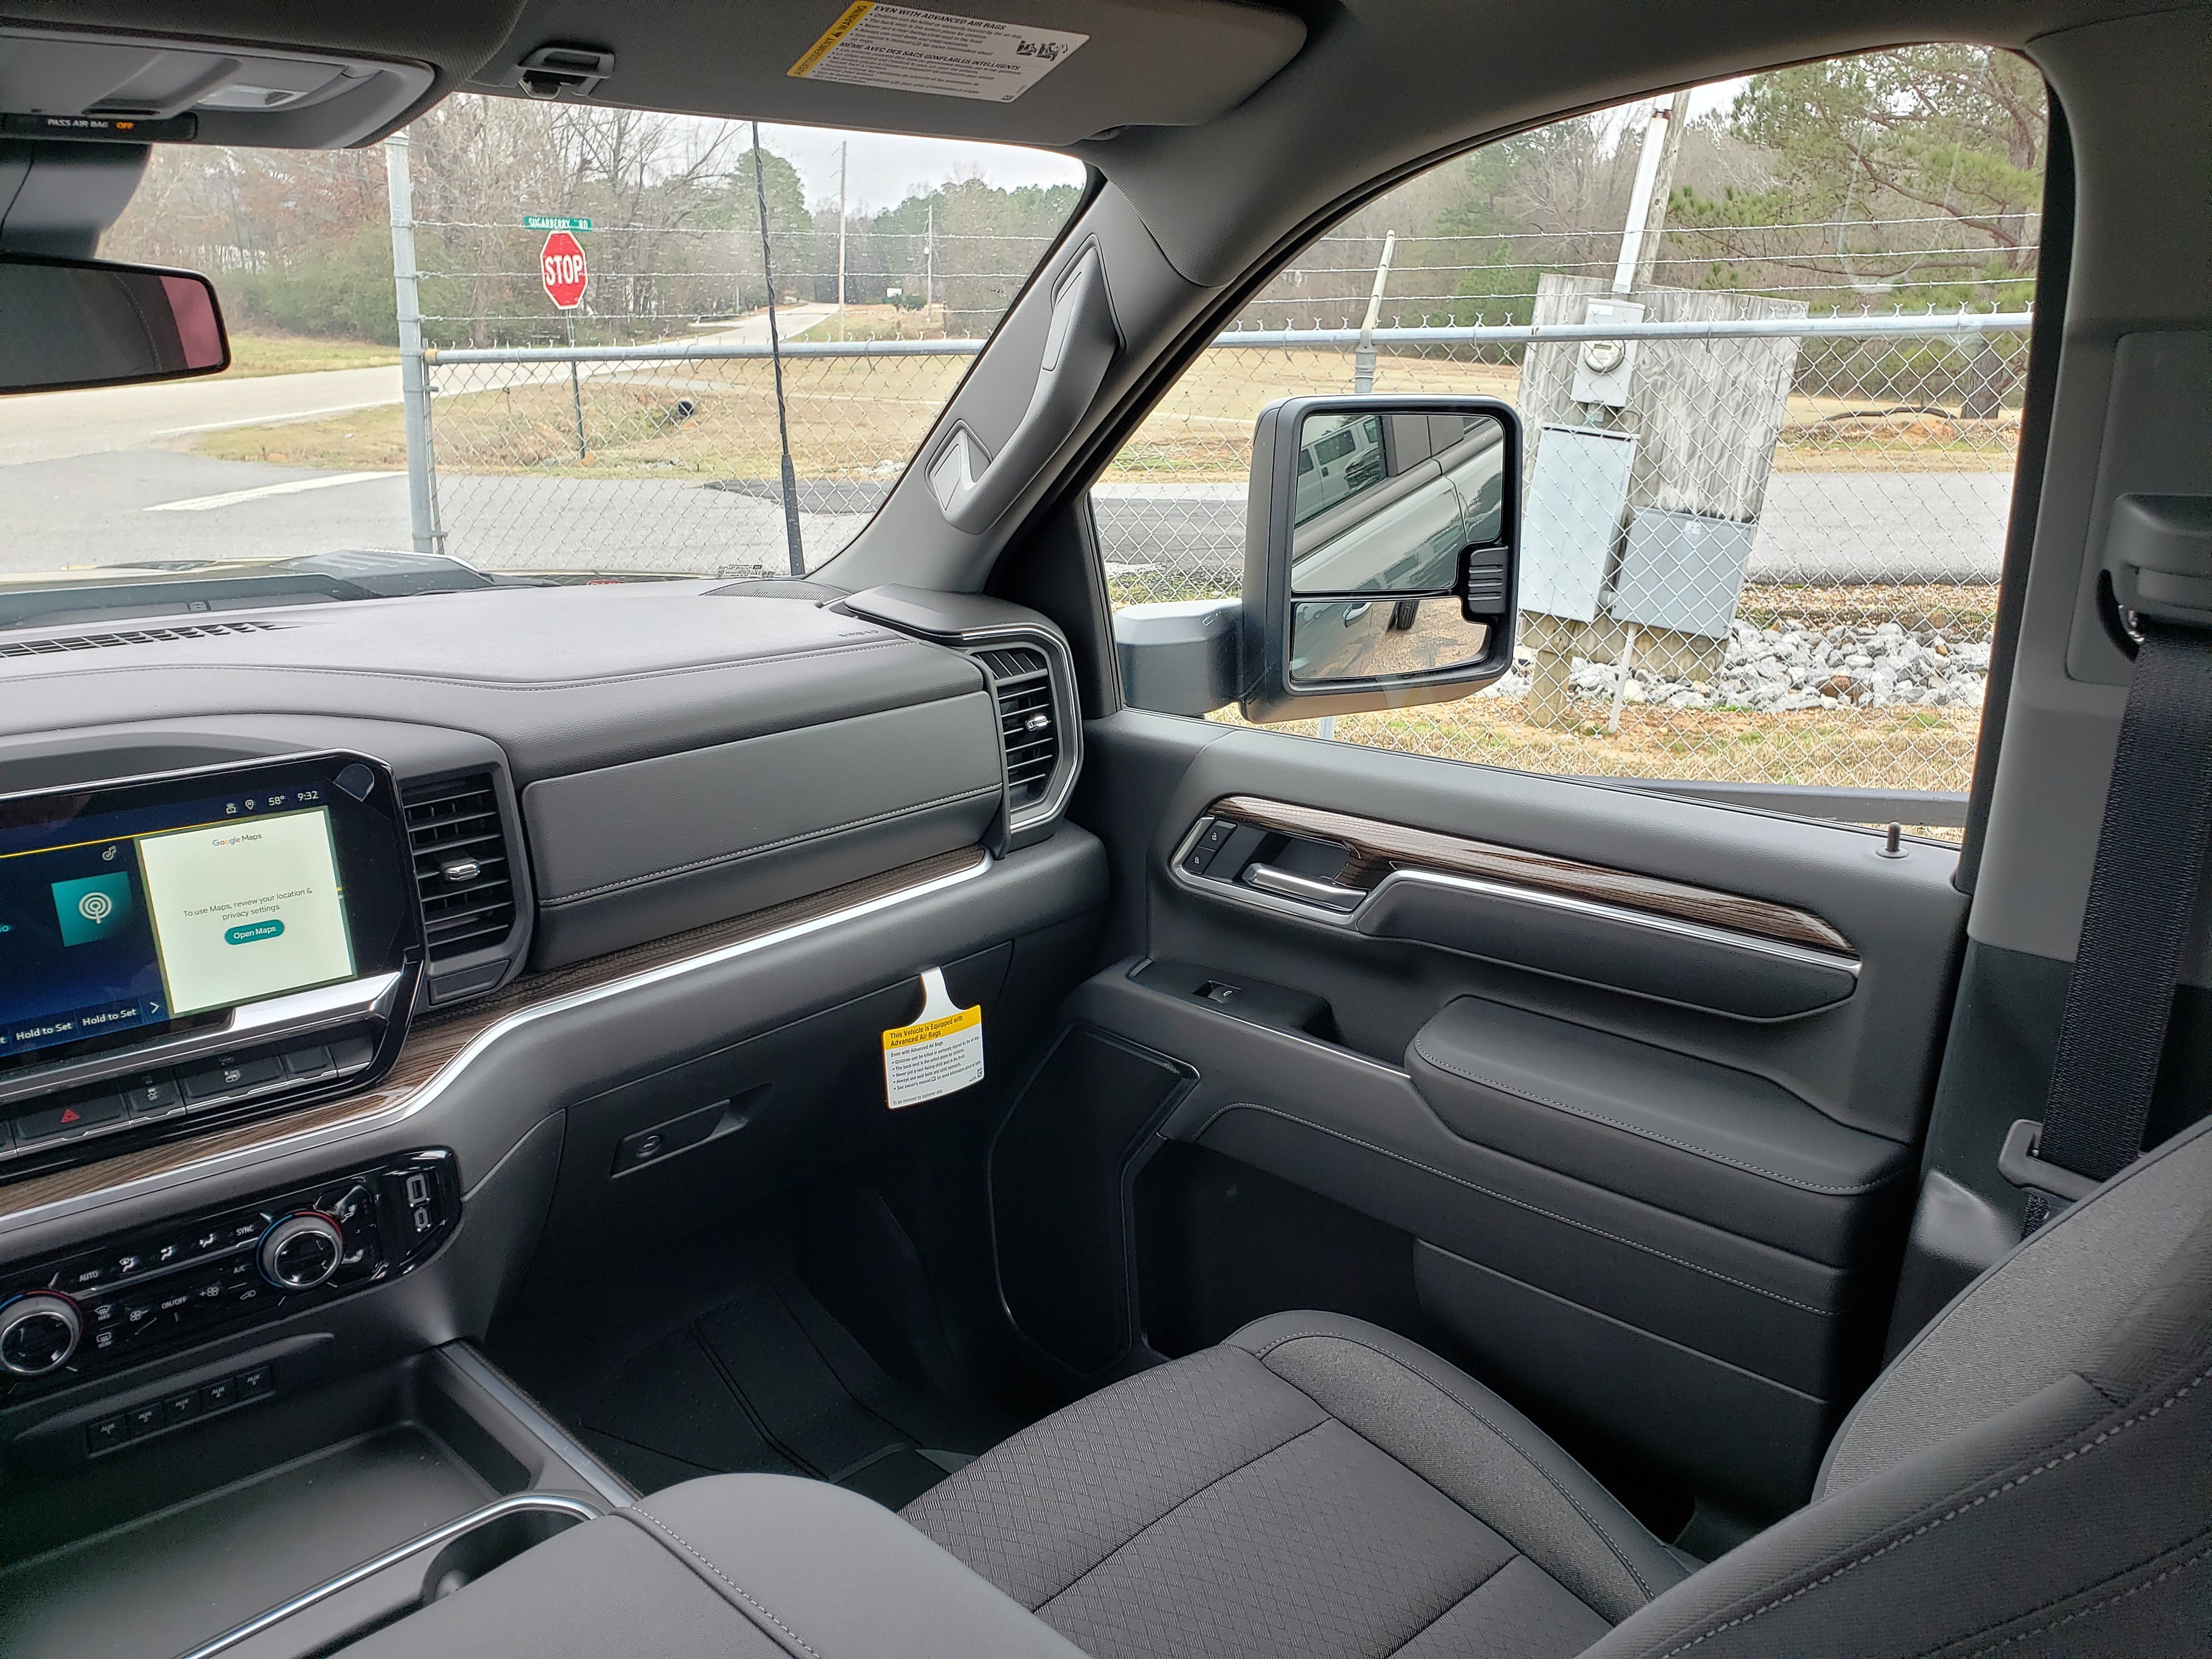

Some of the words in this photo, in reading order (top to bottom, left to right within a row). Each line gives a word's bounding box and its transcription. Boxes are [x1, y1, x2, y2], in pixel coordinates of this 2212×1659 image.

[837, 5, 867, 30] WARNING
[921, 14, 967, 23] ADVANCED
[924, 54, 971, 64] GONFLABLES
[972, 60, 1020, 70] INTELLIGENTS
[528, 217, 571, 229] SUGARBERRY
[578, 219, 589, 229] RD
[545, 255, 583, 286] STOP
[268, 795, 285, 806] 58°
[297, 791, 319, 801] 9:32
[212, 837, 240, 846] Google
[210, 903, 232, 912] Maps,
[234, 899, 257, 907] review
[259, 895, 275, 904] your
[276, 889, 305, 899] location
[222, 910, 249, 921] privacy
[251, 905, 280, 914] settings
[233, 930, 255, 939] Open
[256, 926, 276, 935] Maps
[82, 1015, 105, 1026] Hold
[108, 1012, 119, 1020] to
[121, 1008, 137, 1018] Set
[15, 1029, 40, 1040] Hold
[55, 1022, 72, 1032] Set
[904, 1027, 924, 1036] Vehicle
[930, 1018, 952, 1030] Equipped
[890, 1035, 918, 1047] Advanced
[911, 1045, 928, 1053] Advanced
[236, 1225, 254, 1236] SYNC
[234, 1265, 246, 1274] A/C
[80, 1271, 98, 1282] AUTO
[161, 1296, 187, 1309] ON/OFF
[247, 1374, 261, 1383] AUX
[212, 1386, 225, 1395] AUX
[176, 1398, 189, 1407] AUX
[139, 1411, 152, 1419] AUX
[101, 1424, 115, 1432] AUX
